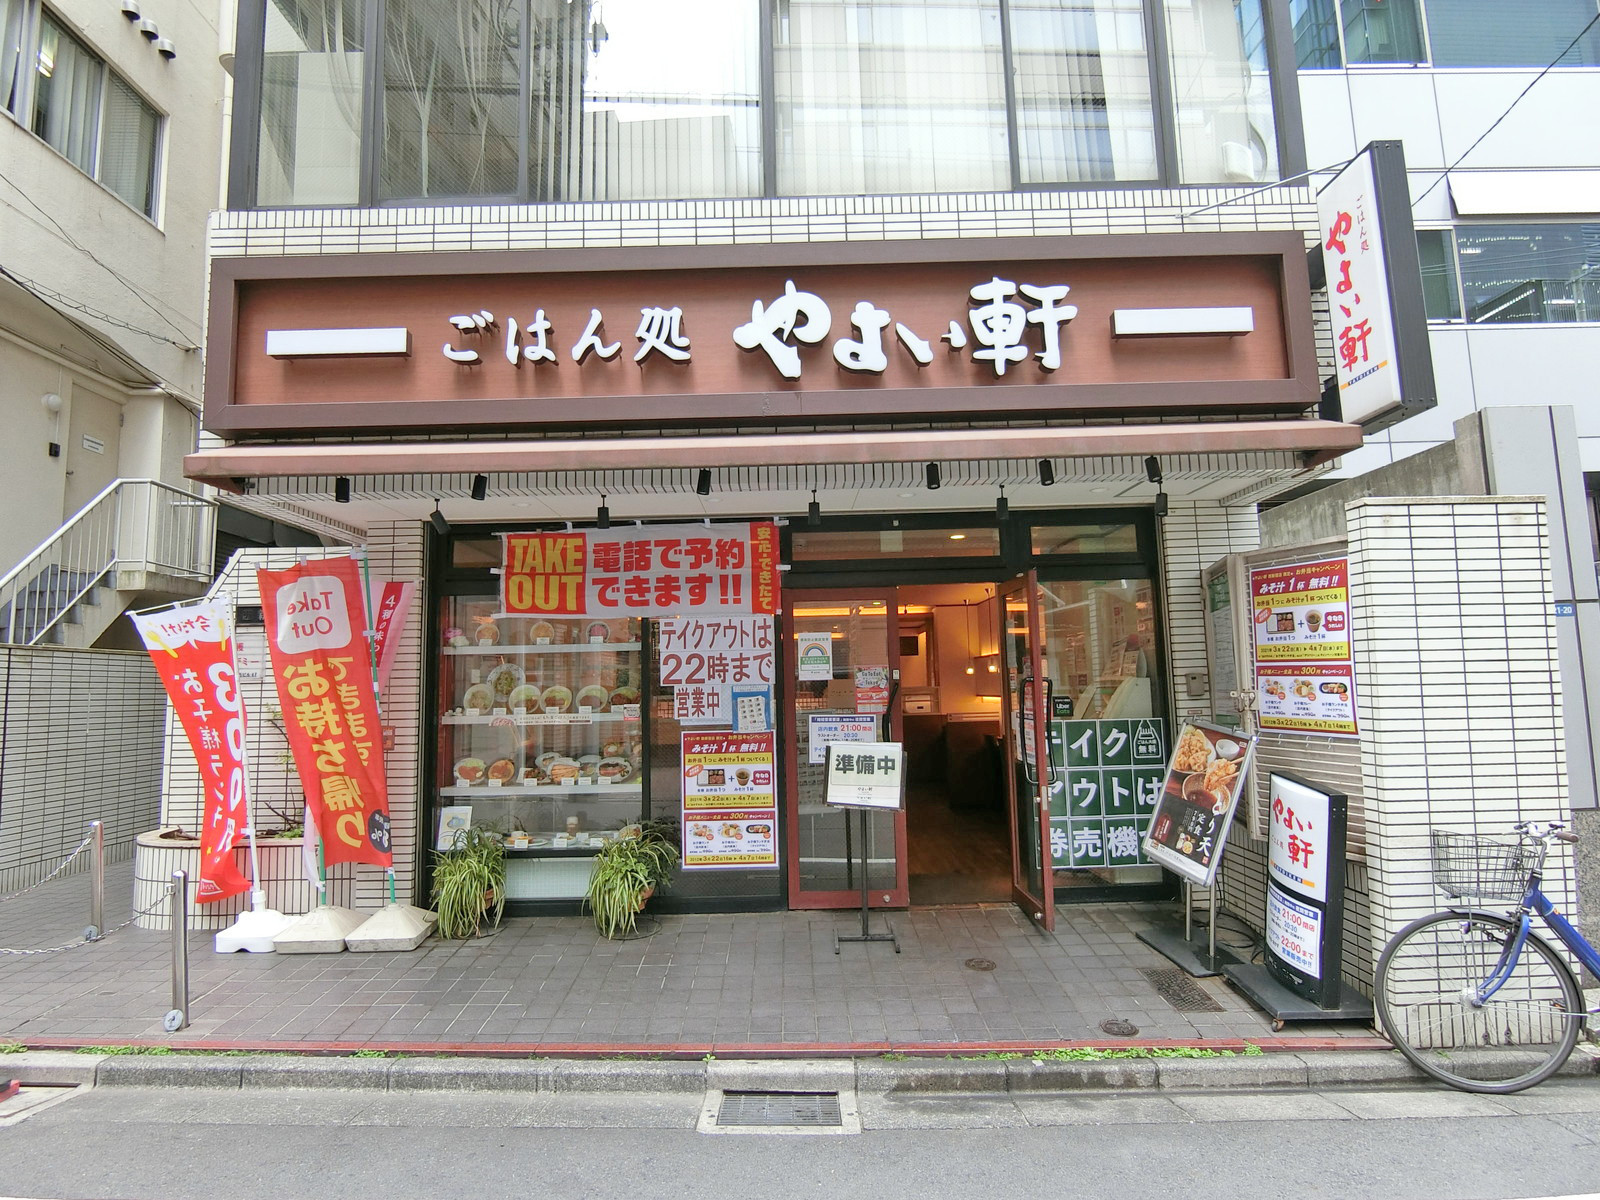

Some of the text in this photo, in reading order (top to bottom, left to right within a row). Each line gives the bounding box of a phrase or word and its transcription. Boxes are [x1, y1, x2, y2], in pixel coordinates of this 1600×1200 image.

[1325, 210, 1373, 373] やよい軒
[443, 276, 1078, 379] ごはん処 やよい軒
[510, 538, 584, 573] TAKE
[592, 538, 745, 573] 電話で予約
[508, 574, 584, 611] OUT
[591, 573, 742, 608] できます!!
[1259, 581, 1286, 594] みそ汁
[661, 618, 773, 650] テイクアウトは
[662, 652, 773, 685] 22時まで
[675, 686, 720, 718] 営業中
[691, 743, 718, 753] みそ汁
[1138, 744, 1156, 754] 無料
[835, 754, 896, 775] 準備中
[1282, 908, 1302, 926] 21:00
[1281, 935, 1302, 954] 22:00
